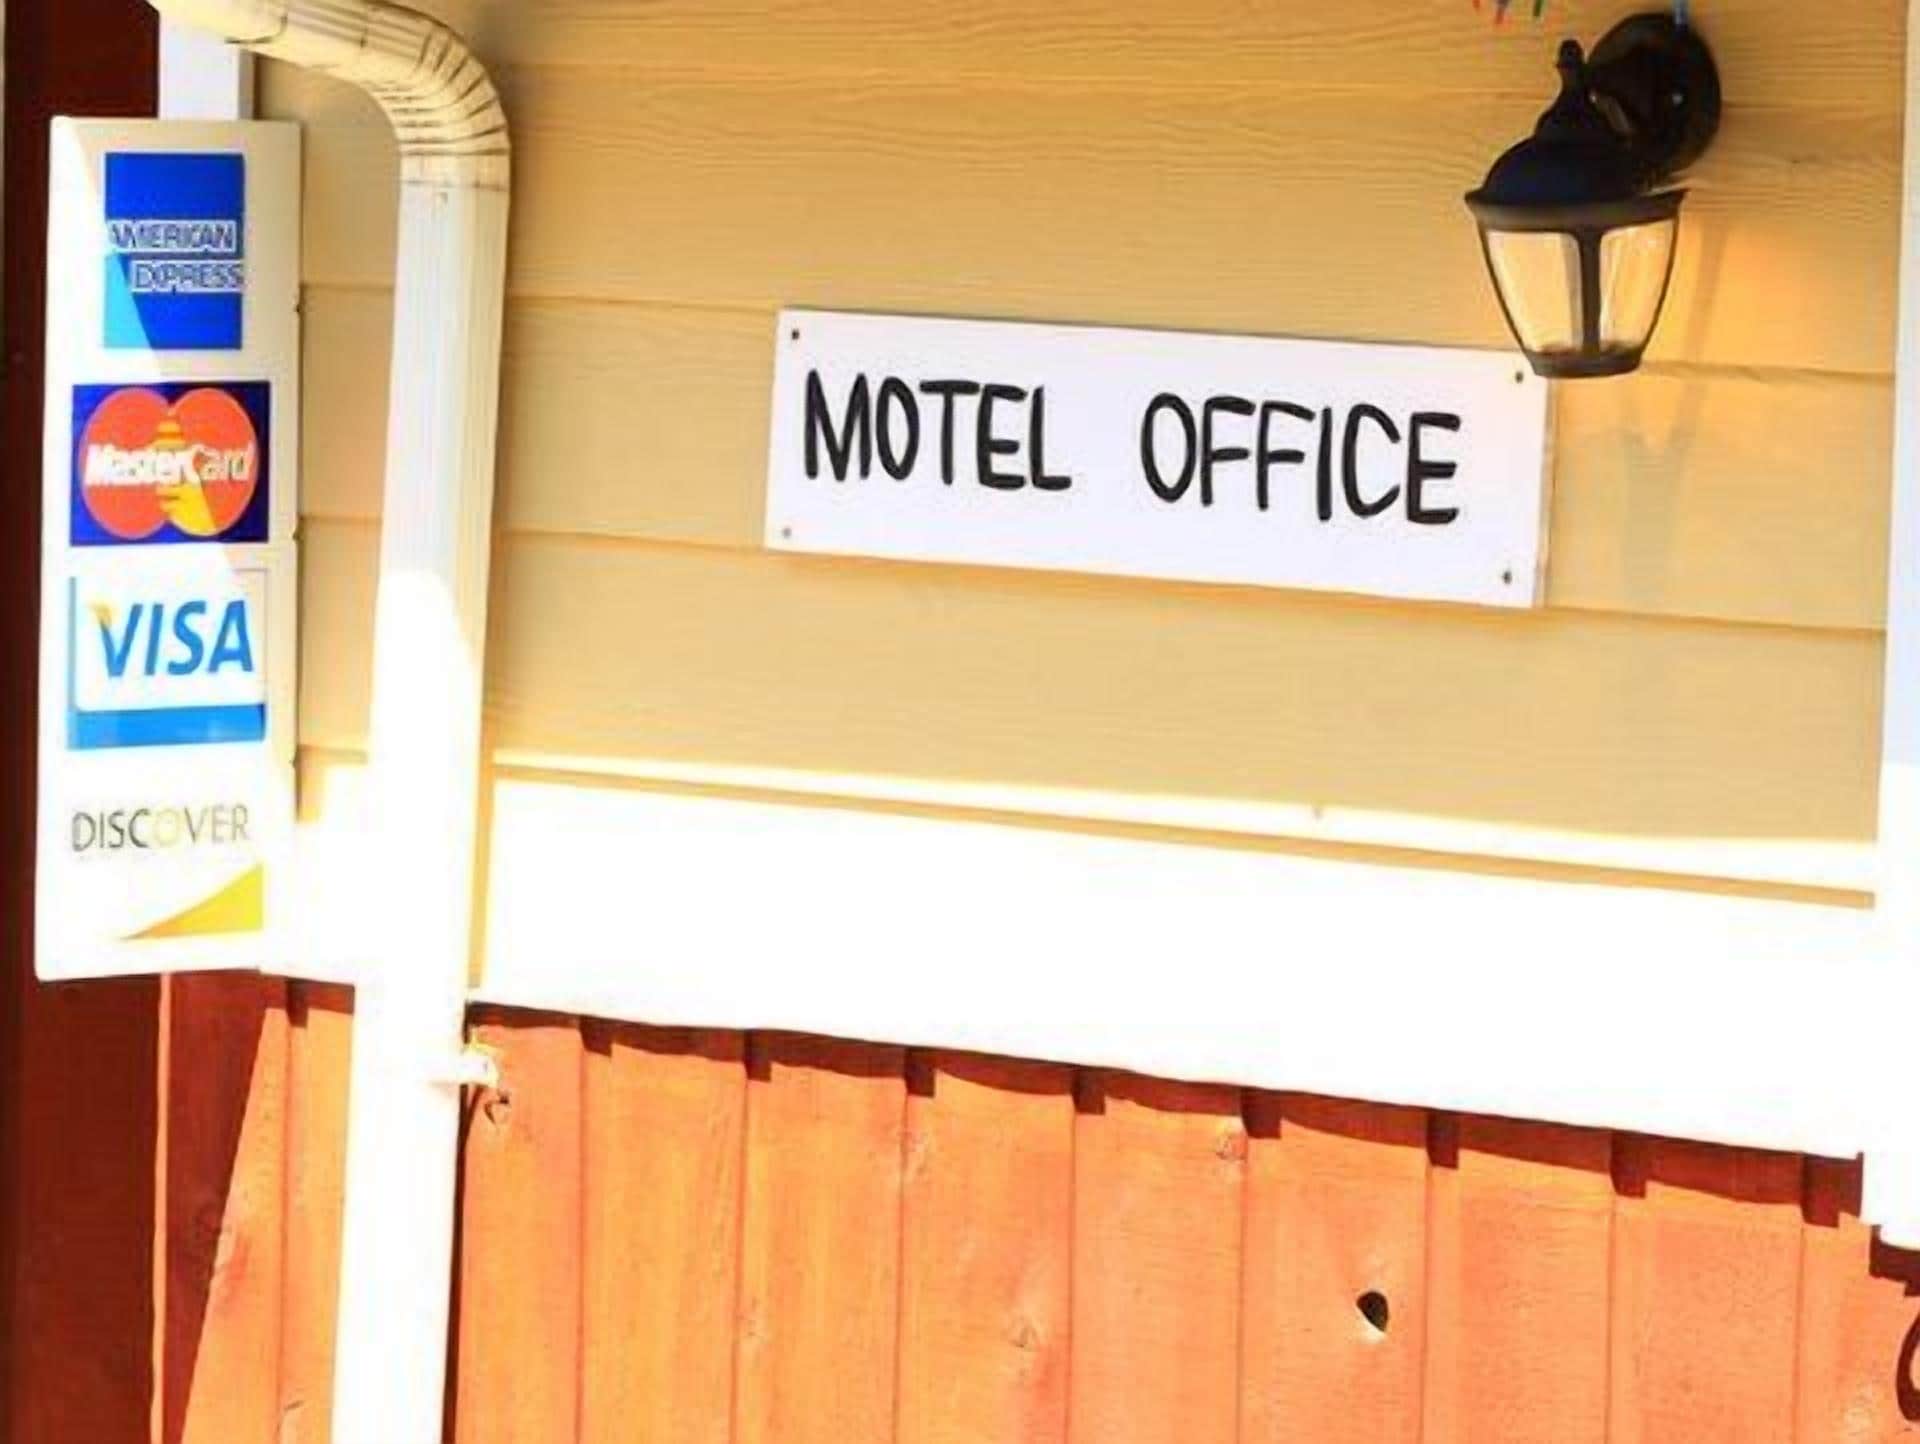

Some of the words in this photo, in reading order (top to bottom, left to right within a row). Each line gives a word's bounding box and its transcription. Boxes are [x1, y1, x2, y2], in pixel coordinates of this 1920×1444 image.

[803, 369, 1072, 491] MOTEL
[1140, 392, 1462, 525] OFFICE
[89, 599, 255, 677] VISA
[71, 803, 249, 852] DISCOVER
